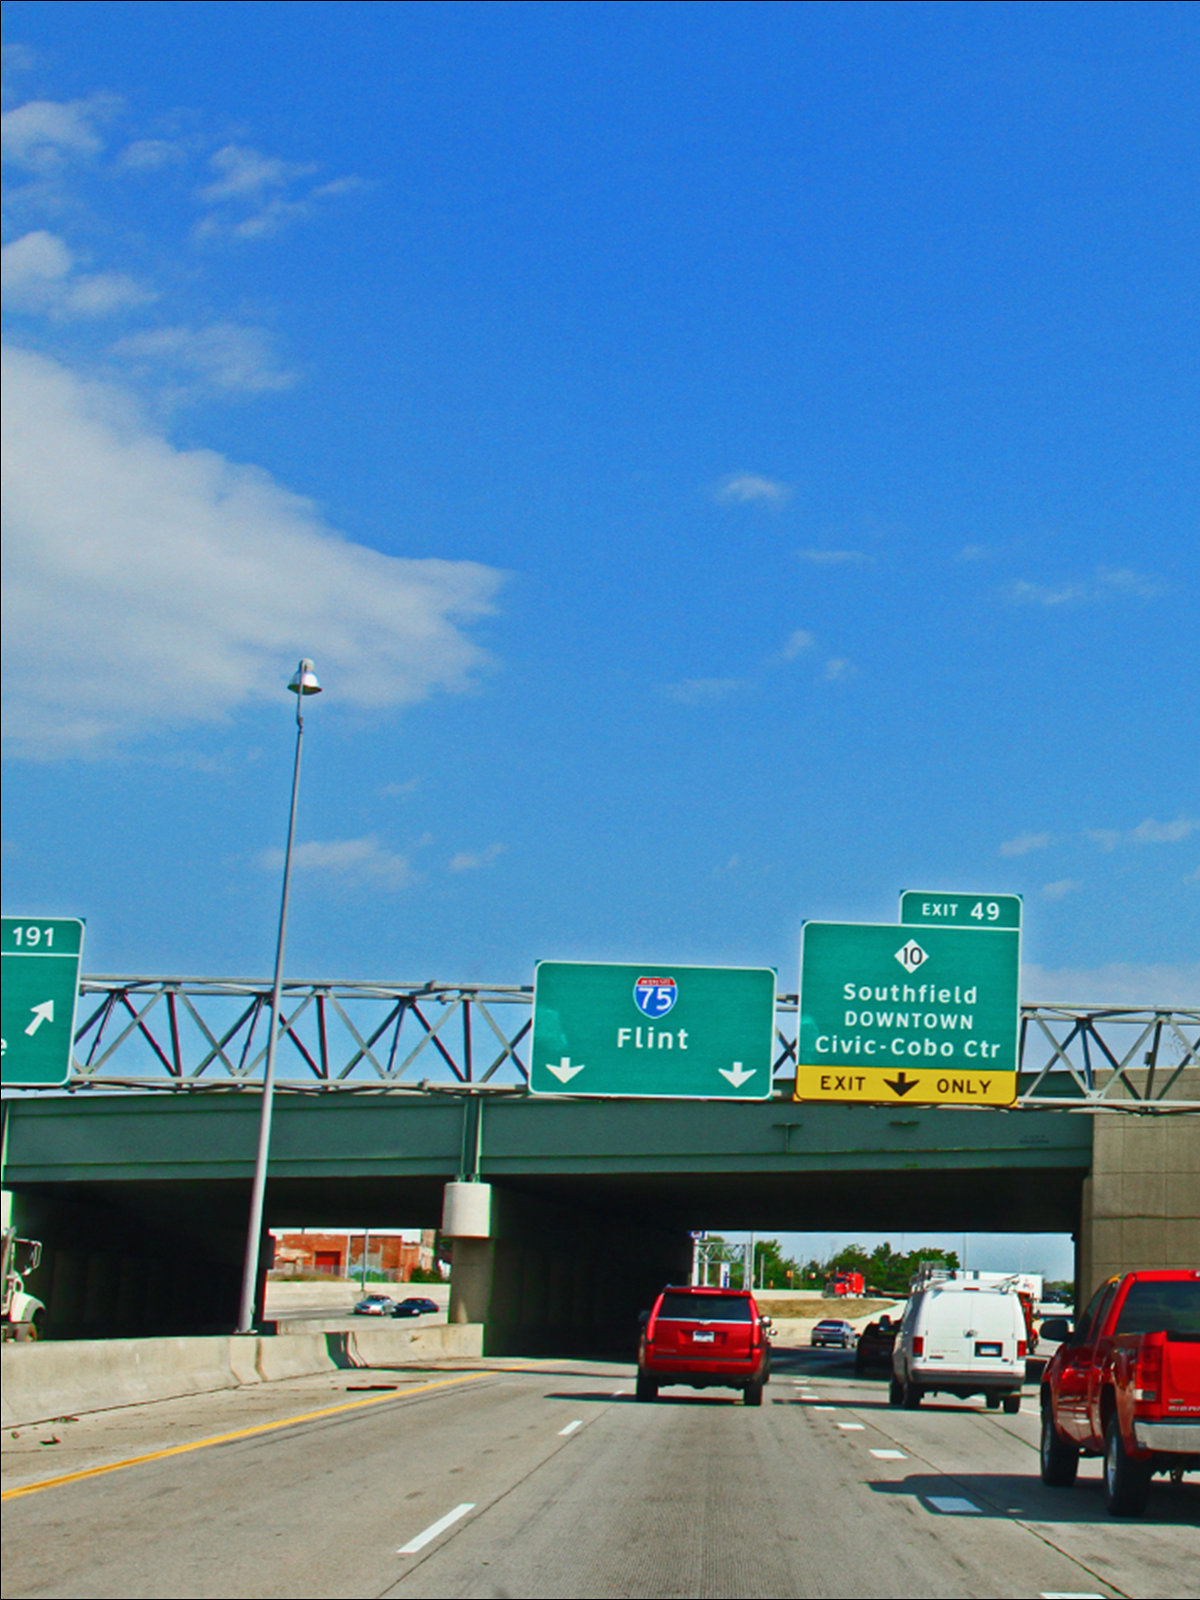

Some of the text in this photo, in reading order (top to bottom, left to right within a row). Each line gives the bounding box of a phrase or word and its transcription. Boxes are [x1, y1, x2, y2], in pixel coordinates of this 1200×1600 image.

[922, 902, 1000, 920] EXIT 49
[12, 926, 54, 947] 191
[903, 946, 923, 965] 10
[638, 987, 672, 1010] 75
[843, 983, 977, 1004] Southfield
[844, 1010, 973, 1030] DOWNTOWN
[617, 1027, 689, 1050] Flint
[815, 1035, 1001, 1058] Civic-Cobo Ctr
[820, 1075, 992, 1094] EXIT ONLY
